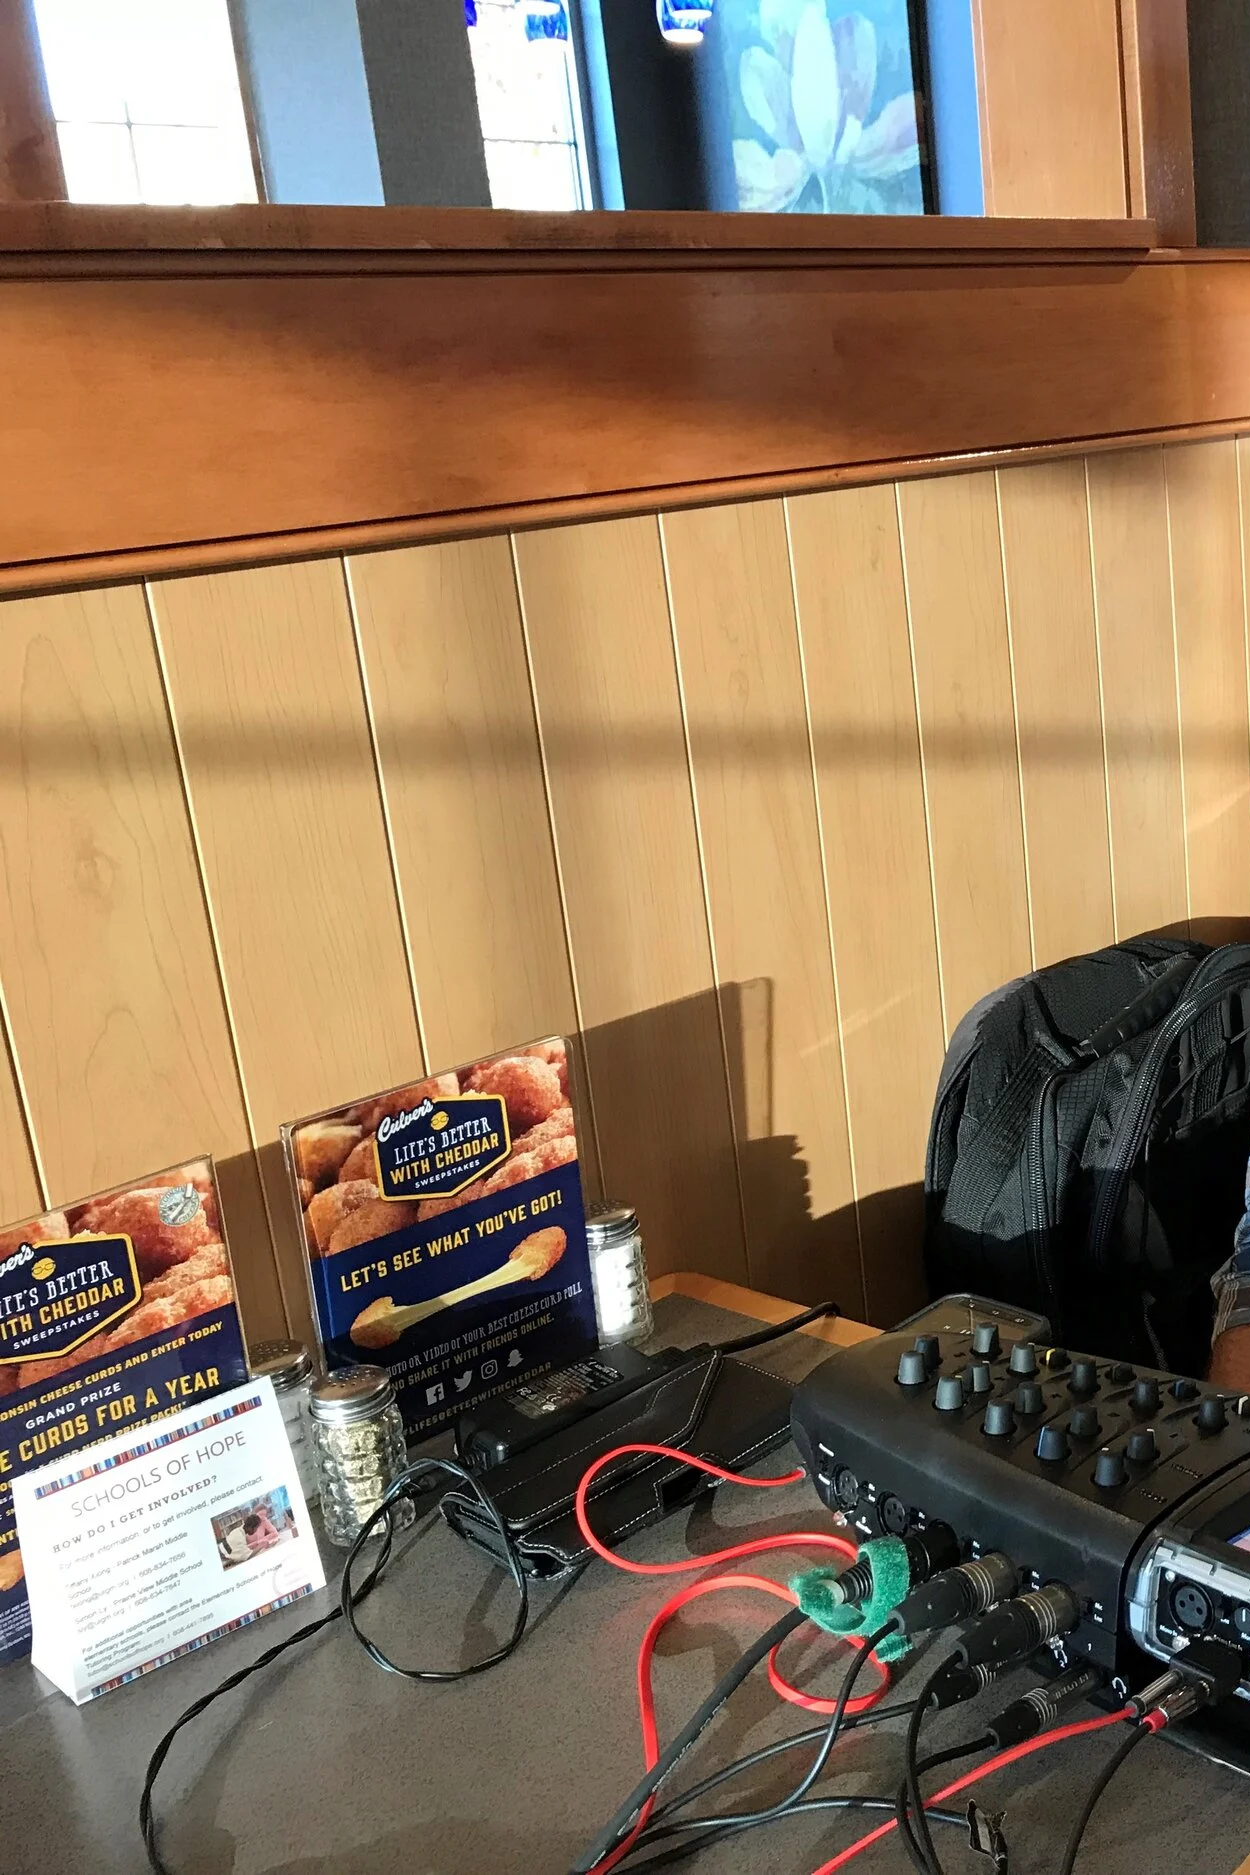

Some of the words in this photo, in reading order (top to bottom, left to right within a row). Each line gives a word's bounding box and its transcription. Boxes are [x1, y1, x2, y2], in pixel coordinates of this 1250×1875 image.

[377, 1098, 434, 1142] Culver's
[394, 1137, 436, 1165] LIFE'S
[441, 1116, 492, 1148] BETTER
[389, 1158, 431, 1185] WITH
[435, 1132, 499, 1168] CHEDDAR
[414, 1159, 480, 1189] SWEEPSTAKES
[340, 1260, 388, 1292] LET'S
[393, 1246, 423, 1272] SEE
[426, 1227, 470, 1258] WHAT
[475, 1205, 527, 1238] YOU'VE
[530, 1189, 563, 1216] GOT!
[39, 1277, 125, 1325] CHEDDAR
[46, 1260, 114, 1301] BETTER
[13, 1310, 100, 1350] SWEEPSTAKES
[386, 1361, 408, 1378] HOTO
[408, 1356, 422, 1370] OR
[423, 1342, 450, 1362] VIDEO
[450, 1336, 461, 1350] OF
[462, 1327, 487, 1345] YOUR
[488, 1316, 509, 1334] BEST
[509, 1303, 540, 1325] CHEESE
[540, 1291, 563, 1312] CURD
[563, 1281, 583, 1299] PULL
[40, 1380, 83, 1405] CHEESE
[84, 1363, 123, 1385] CURDS
[125, 1352, 149, 1369] AND
[151, 1337, 186, 1358] ENTER
[187, 1320, 223, 1342] TODAY
[408, 1365, 439, 1386] SHARE
[441, 1358, 451, 1371] IT
[453, 1348, 479, 1365] WITH
[481, 1330, 519, 1353] FRIENDS
[18, 1414, 90, 1462] CURDS
[96, 1394, 137, 1426] FOR
[145, 1388, 159, 1409] A
[165, 1367, 220, 1400] YEAR
[25, 1402, 76, 1430] GRAND
[81, 1382, 122, 1407] PRIZE
[71, 1468, 162, 1517] SCHOOLS
[166, 1453, 193, 1476] OF
[196, 1431, 246, 1464] HOPE
[52, 1534, 83, 1553] HOW
[88, 1525, 105, 1539] DO
[110, 1519, 116, 1528] I
[120, 1508, 144, 1524] GET
[148, 1475, 218, 1512] INVOLVED?
[153, 1520, 160, 1529] to
[162, 1514, 175, 1529] get
[210, 1489, 235, 1505] please
[236, 1475, 263, 1493] contact
[142, 1543, 164, 1556] Marsh
[164, 1531, 188, 1546] Middle
[155, 1572, 178, 1586] Middle
[179, 1559, 203, 1575] School
